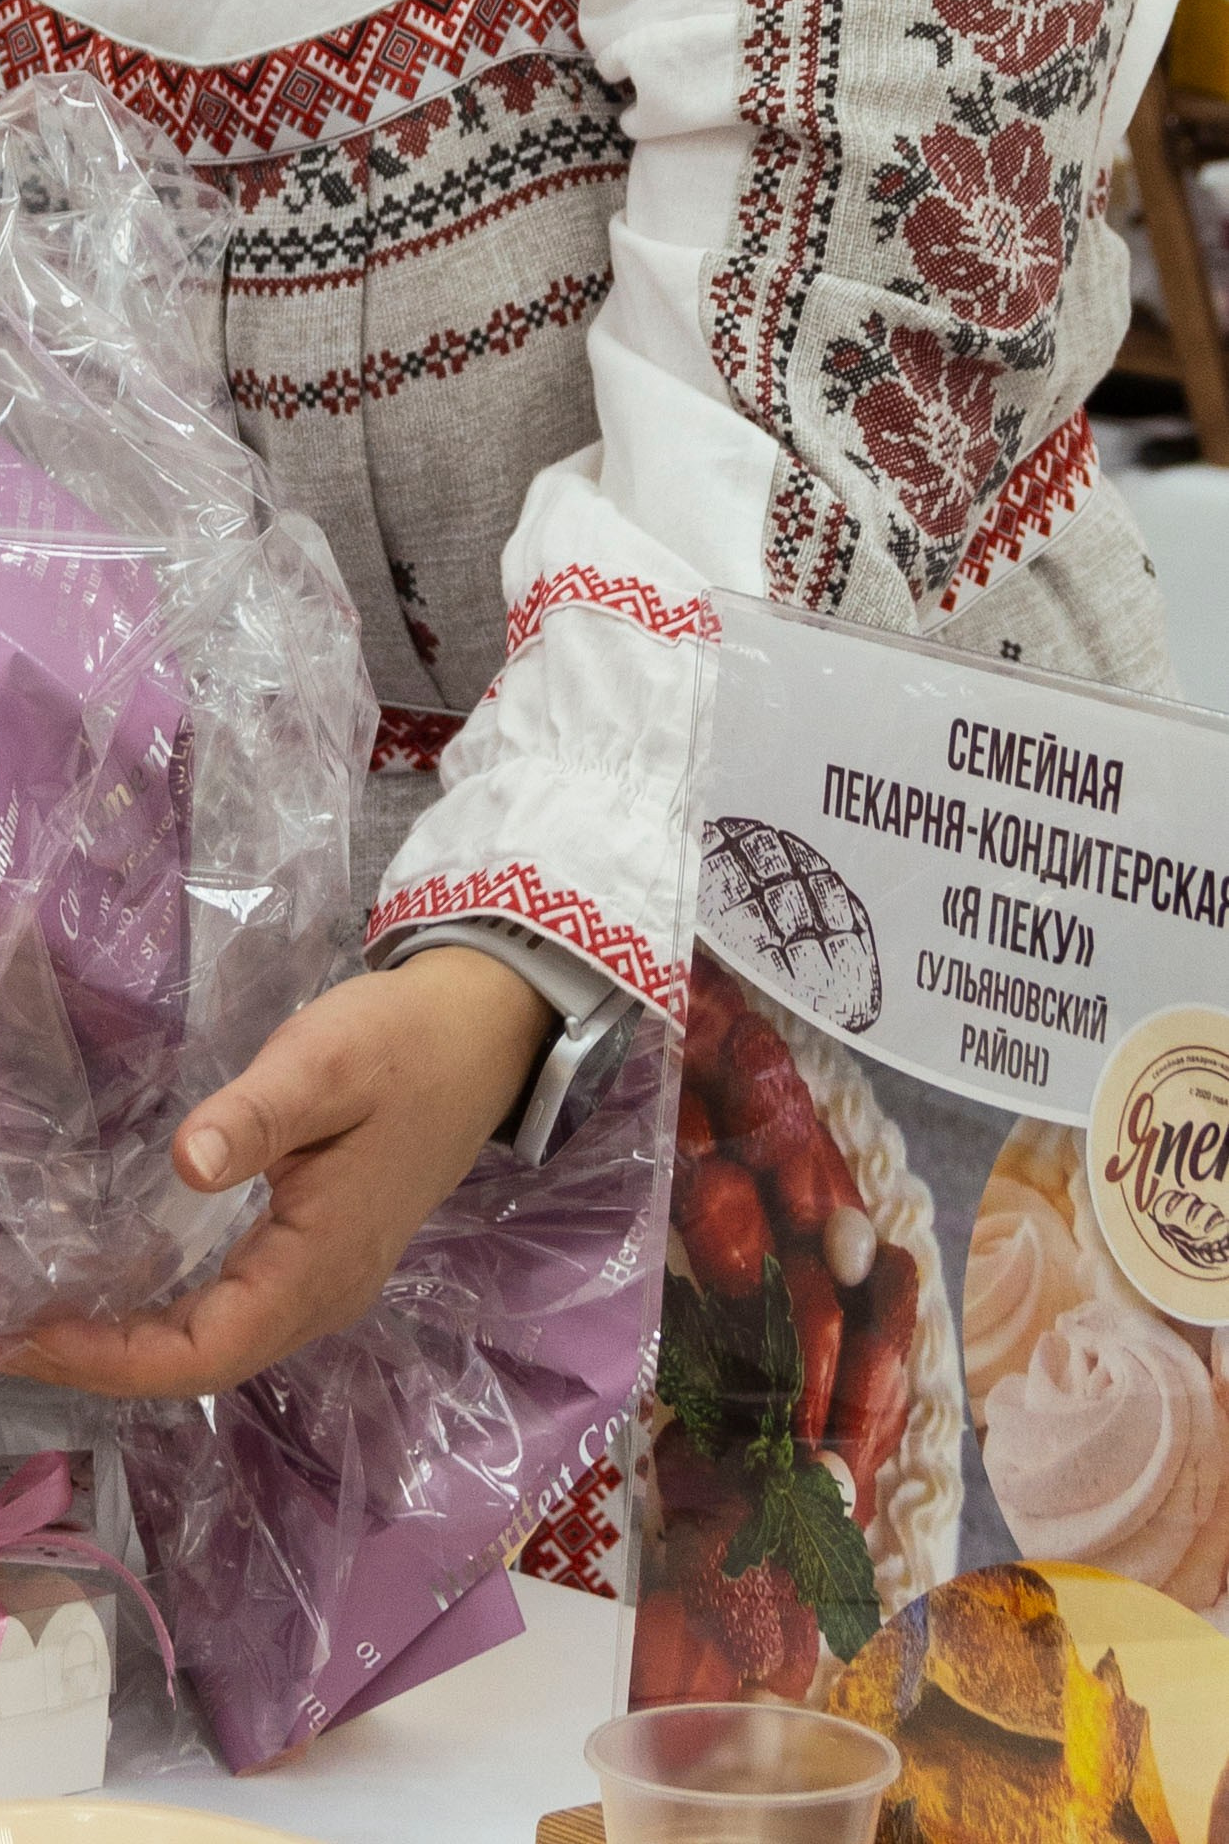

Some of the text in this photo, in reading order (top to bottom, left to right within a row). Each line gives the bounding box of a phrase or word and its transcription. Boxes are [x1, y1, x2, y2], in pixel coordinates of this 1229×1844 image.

[947, 717, 1124, 814] СЕМЕЙНАЯ
[822, 763, 1229, 929] ПЕКАРНЯ-КОНДИТЕРСКАЯ
[941, 884, 1095, 968] «Я ПЕКУ»
[916, 950, 1109, 1045] (УЛЬЯНОВСКИЙ
[959, 1022, 1050, 1087] РАЙОН)
